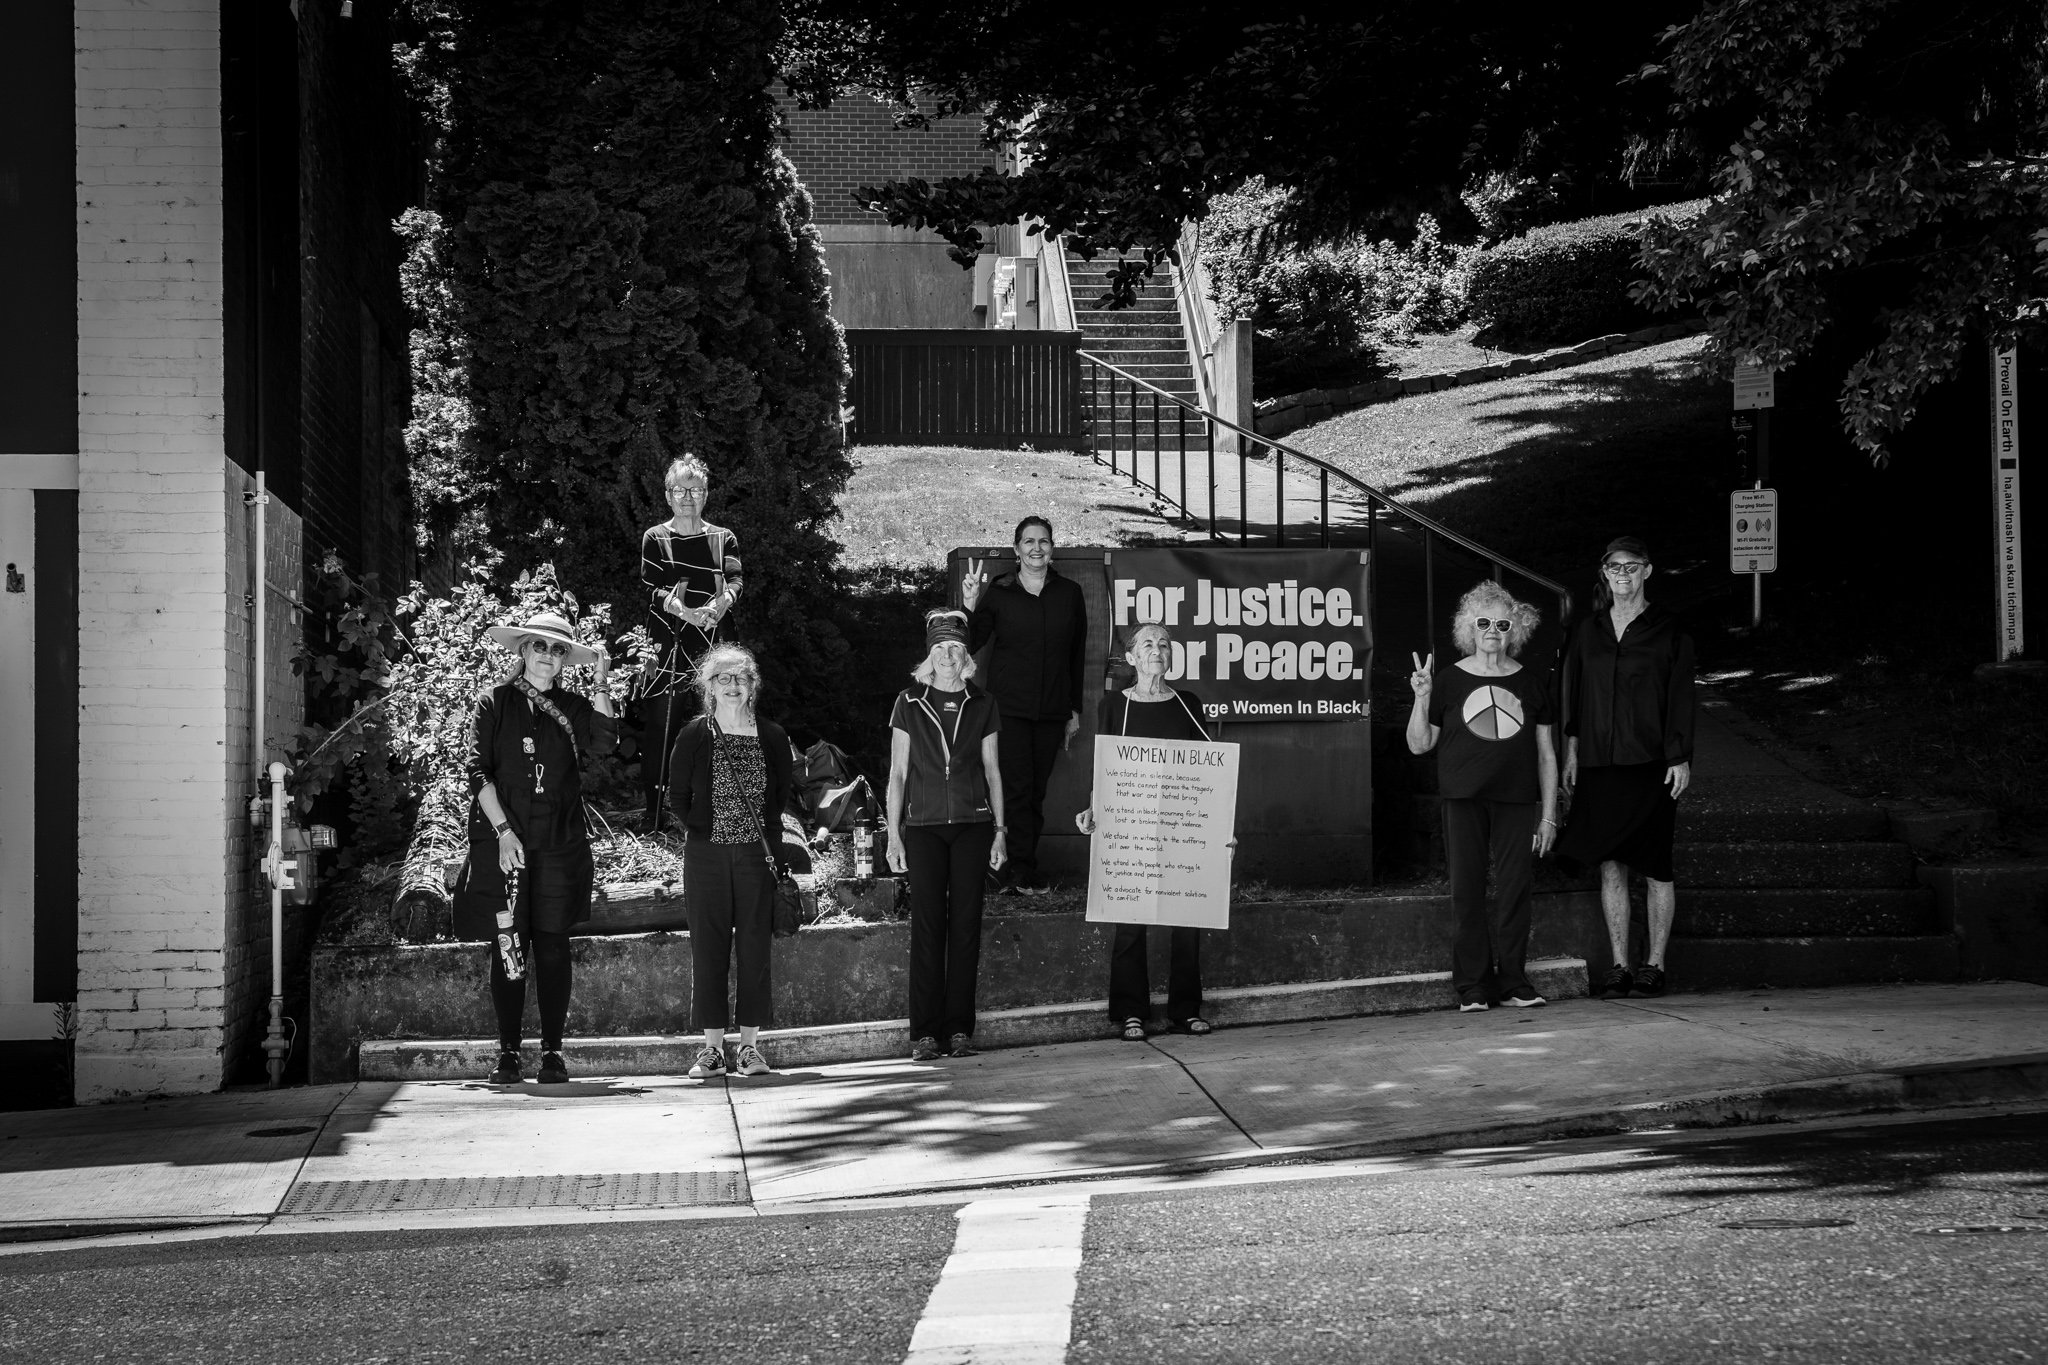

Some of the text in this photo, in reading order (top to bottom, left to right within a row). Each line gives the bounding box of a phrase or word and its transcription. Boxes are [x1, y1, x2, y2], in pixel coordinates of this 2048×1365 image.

[2001, 357, 2013, 452] Prevail On Earth
[2006, 546, 2014, 560] wa
[2007, 564, 2016, 589] skau
[1114, 579, 1363, 627] For Justice.
[2006, 592, 2016, 641] tichampa
[1164, 633, 1363, 680] or Peace.
[1233, 700, 1293, 714] Women
[1298, 700, 1312, 714] In
[1317, 700, 1361, 714] Black
[1117, 745, 1224, 766] WOMEN IN BLACK
[1106, 768, 1118, 776] We
[1120, 769, 1138, 778] stand
[1150, 772, 1174, 780] silence,
[1176, 773, 1200, 781] because
[1116, 789, 1129, 797] that
[1162, 792, 1179, 800] hatred
[1191, 785, 1214, 794] tragedy
[1104, 805, 1114, 813] We
[1117, 804, 1134, 814] stand
[1160, 810, 1184, 819] mourning
[1186, 810, 1195, 818] for
[1115, 815, 1127, 823] lost
[1160, 819, 1179, 829] through
[1114, 832, 1129, 840] stand
[1182, 837, 1206, 849] suffering
[1101, 858, 1111, 866] We
[1113, 858, 1129, 866] stand
[1132, 858, 1144, 867] with
[1113, 870, 1132, 878] justice
[1102, 884, 1112, 892] We
[1114, 885, 1141, 893] advocate
